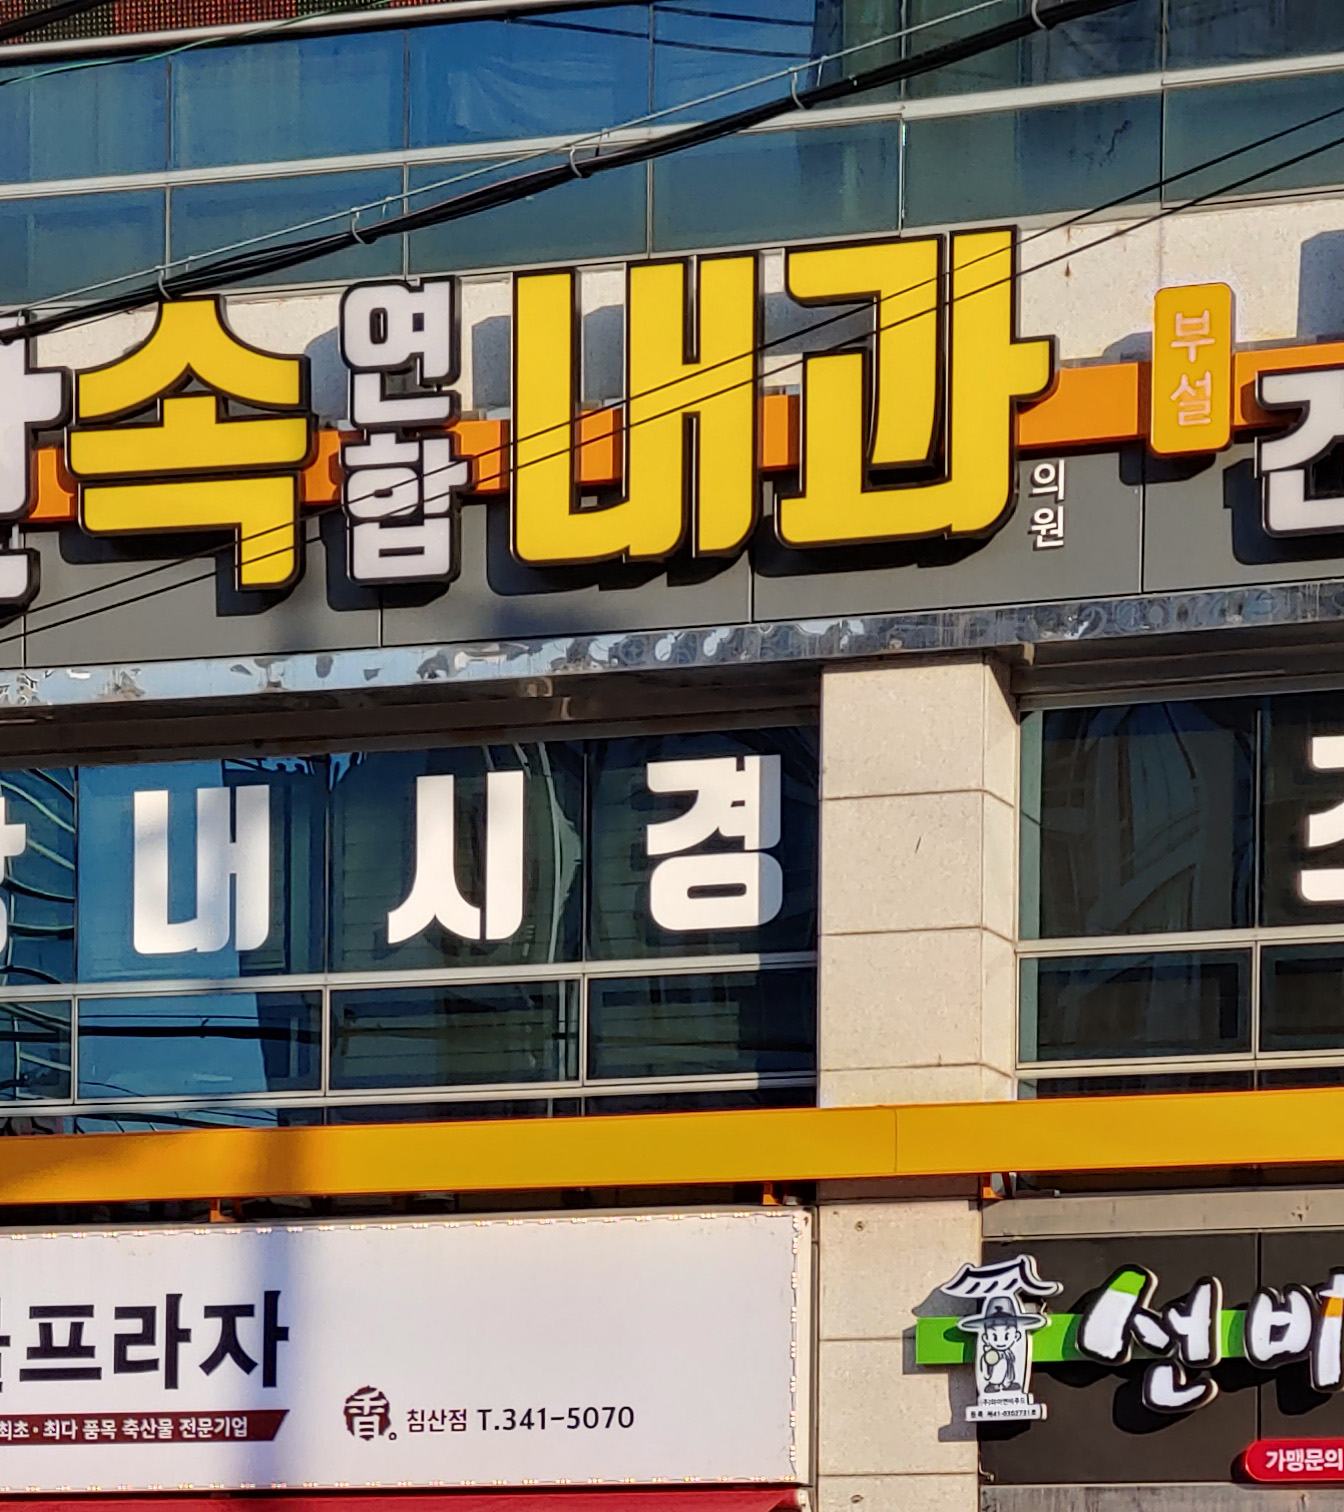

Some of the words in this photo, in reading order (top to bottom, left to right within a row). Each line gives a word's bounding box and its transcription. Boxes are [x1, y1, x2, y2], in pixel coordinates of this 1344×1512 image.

[1168, 310, 1215, 427] 부설
[510, 226, 1056, 567] 내과
[1029, 458, 1065, 551] 의원
[82, 1419, 117, 1440] 품목
[121, 1418, 174, 1440] 축산물
[178, 1416, 248, 1440] 전문기업
[406, 1408, 468, 1433] 침산점
[476, 1405, 635, 1432] T.341-5070
[1264, 1446, 1343, 1472] 가맹문의
